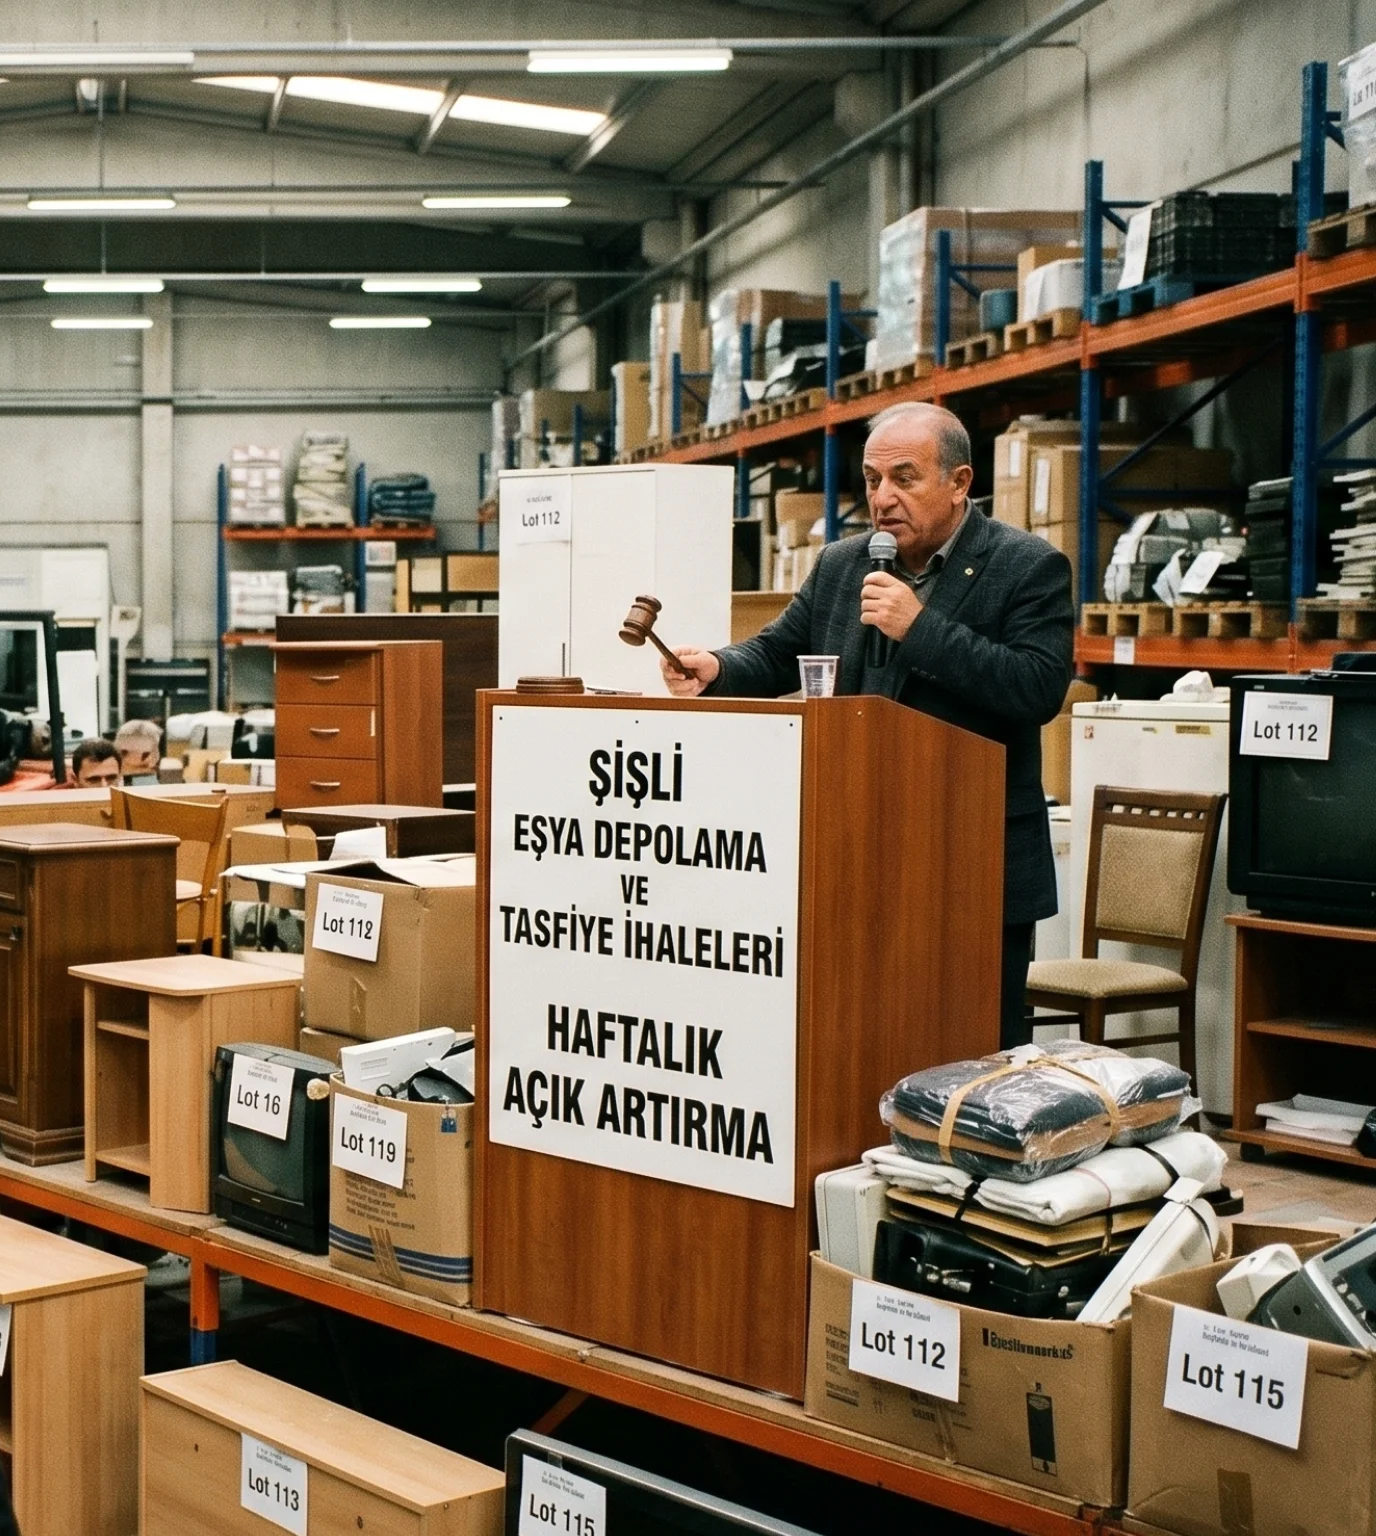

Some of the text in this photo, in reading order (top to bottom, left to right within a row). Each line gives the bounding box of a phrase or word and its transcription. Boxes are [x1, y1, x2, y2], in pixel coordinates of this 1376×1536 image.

[522, 511, 560, 527] Lot 112
[1254, 720, 1318, 742] Lot 112
[589, 740, 683, 809] ŞİŞLİ
[514, 813, 767, 873] EŞYA DEPOLAMA
[620, 874, 649, 906] VE
[322, 911, 344, 935] Lot
[499, 904, 784, 978] TASFİYE İHALELERİ
[547, 1003, 723, 1080] HAFTALIK
[237, 1084, 281, 1115] Lot 16
[503, 1066, 774, 1165] AÇIK ARTIRMA
[341, 1126, 396, 1163] Lot 119
[862, 1322, 896, 1356] Lot
[903, 1334, 946, 1370] 112
[1182, 1353, 1285, 1410] Lot 115
[248, 1467, 300, 1512] Lot 113
[530, 1493, 595, 1536] Lot 115
